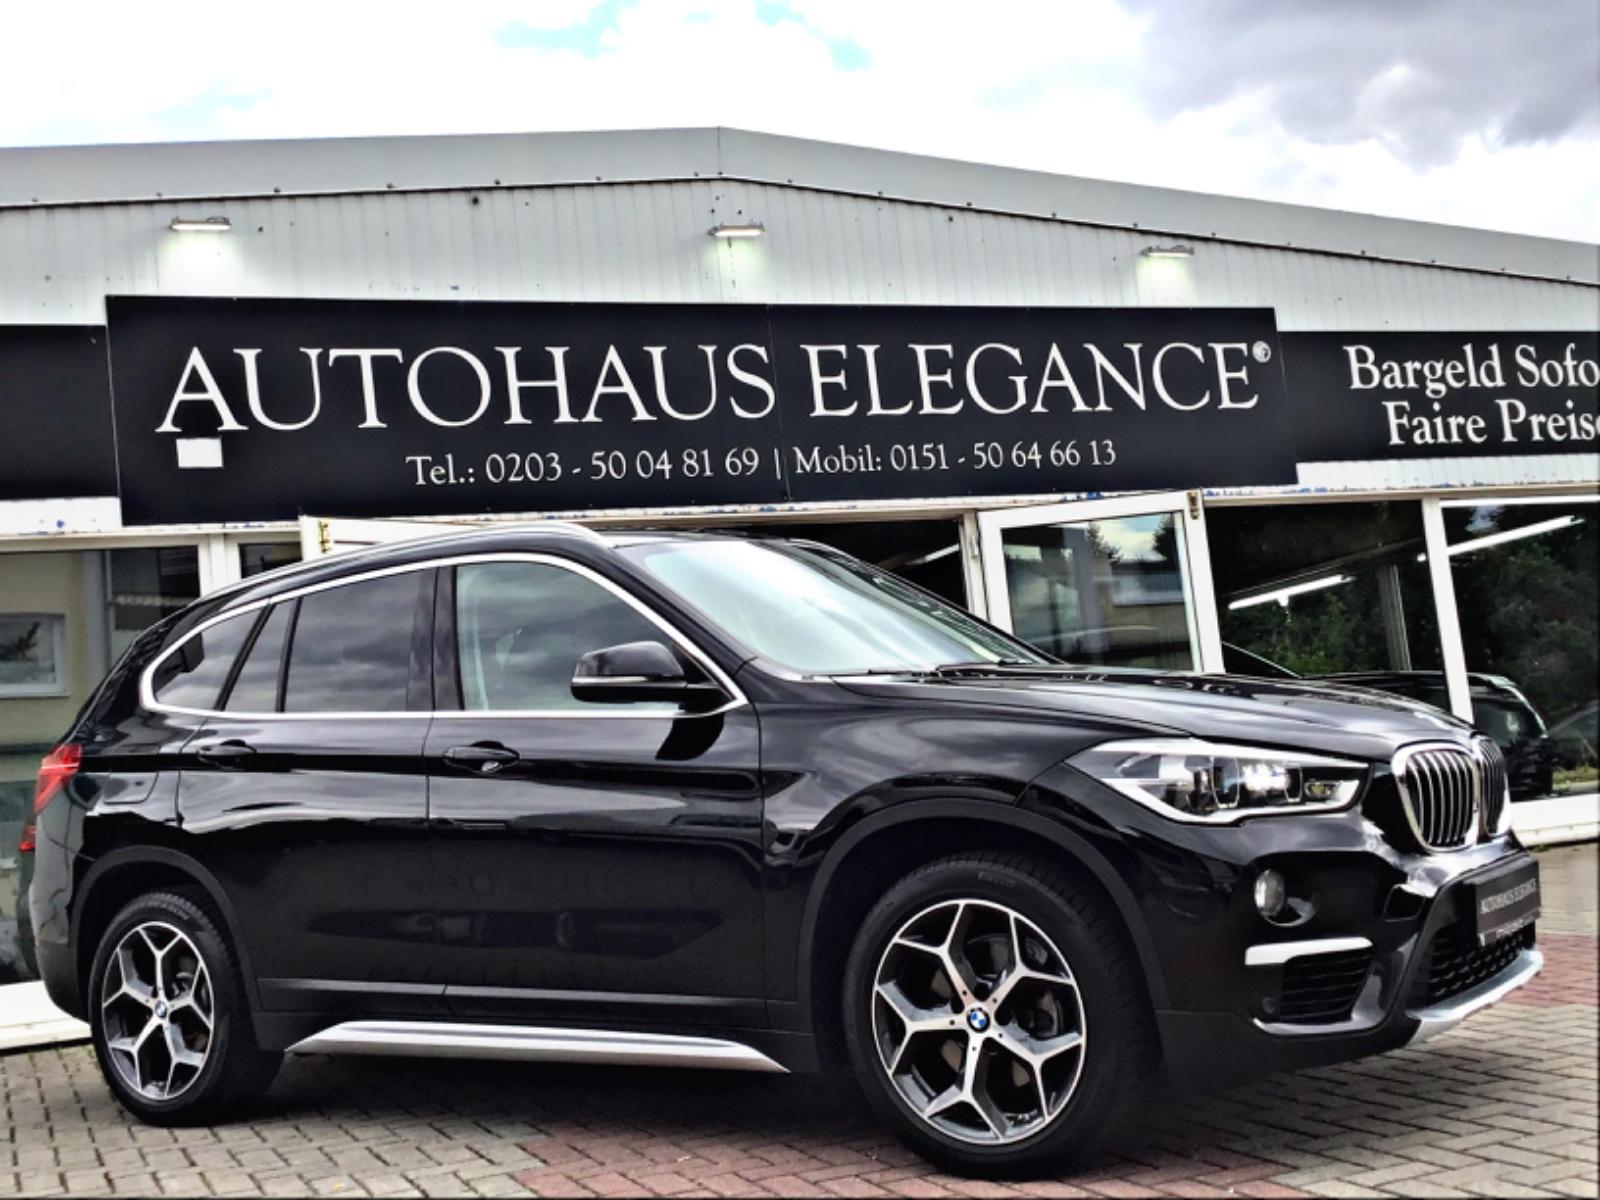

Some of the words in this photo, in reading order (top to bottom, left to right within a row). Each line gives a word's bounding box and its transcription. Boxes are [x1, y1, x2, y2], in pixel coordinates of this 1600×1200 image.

[155, 344, 776, 433] AUTOHAUS
[800, 342, 1259, 417] ELEGANCE
[1343, 343, 1506, 398] Bargeld
[1515, 343, 1600, 387] Sofo
[1382, 400, 1488, 445] Faire
[405, 453, 476, 485] Tel.:
[485, 452, 562, 483] 0203
[590, 450, 627, 480] 50
[635, 449, 673, 480] 04
[682, 448, 714, 478] 81
[724, 447, 760, 476] 69
[794, 444, 882, 474] Mobil:
[889, 442, 950, 472] 0151
[973, 441, 1004, 470] 50
[1011, 440, 1043, 469] 64
[1049, 440, 1081, 467] 66
[1090, 438, 1117, 466] 13
